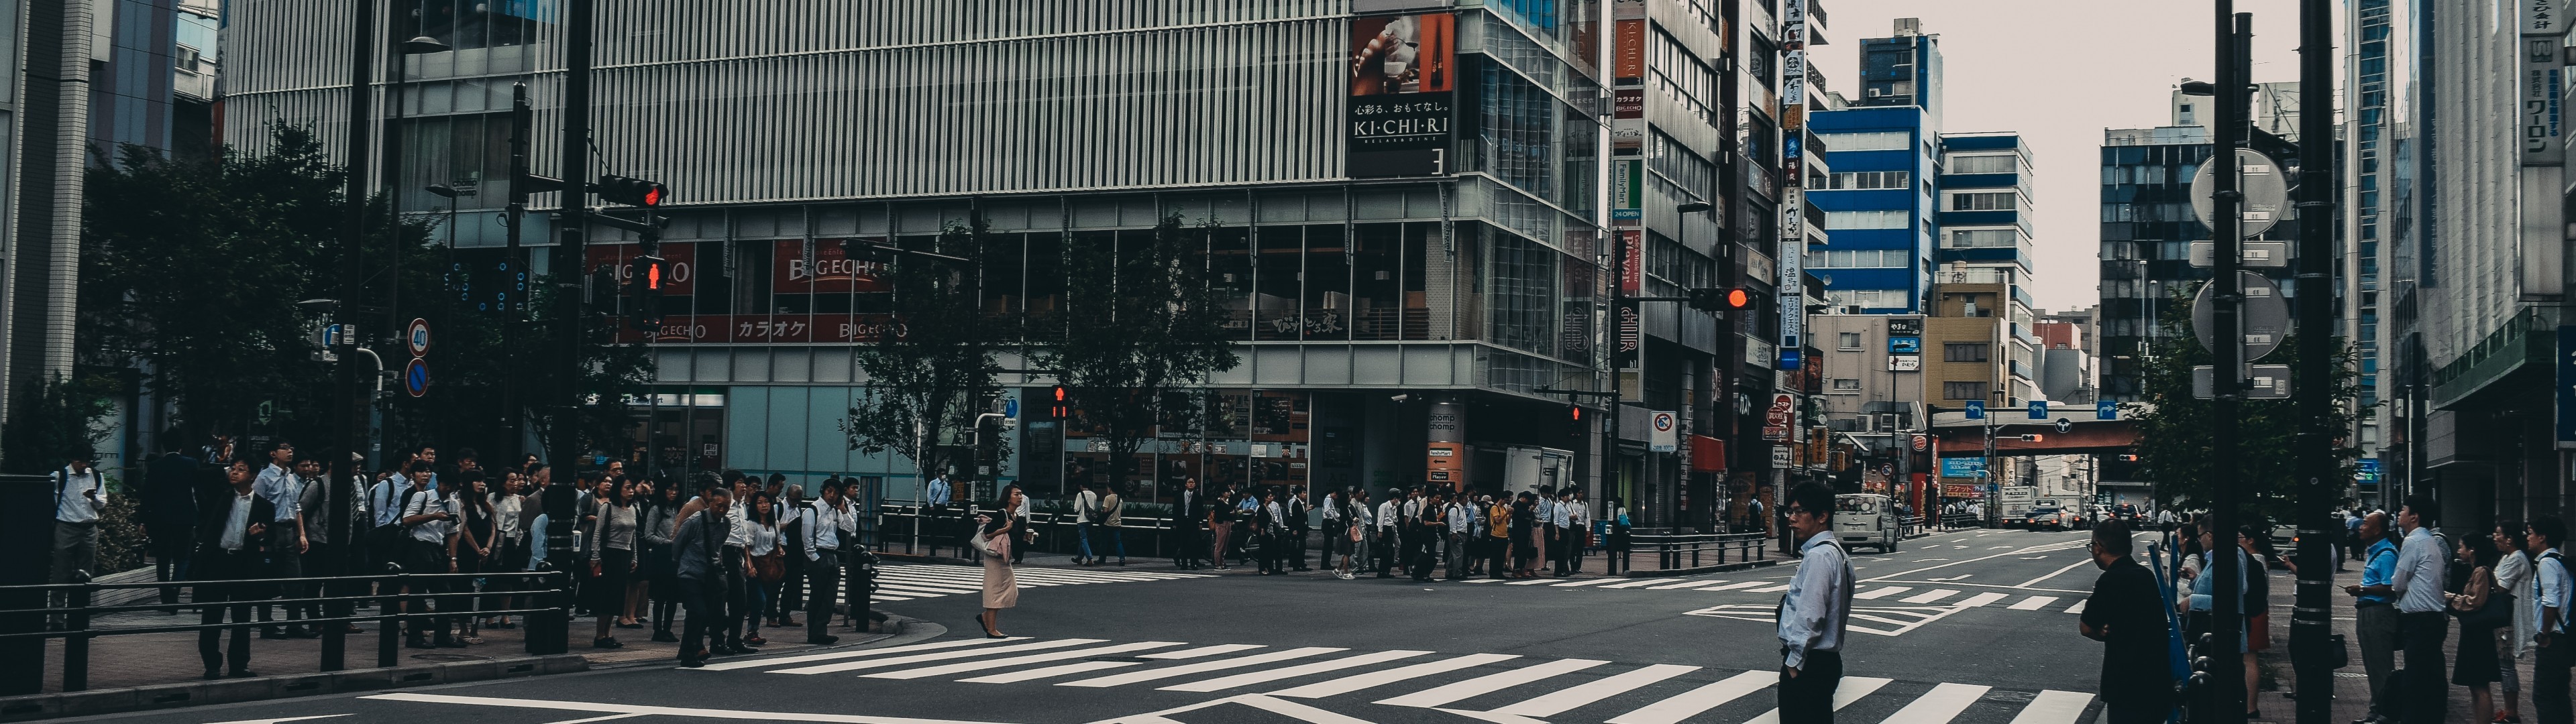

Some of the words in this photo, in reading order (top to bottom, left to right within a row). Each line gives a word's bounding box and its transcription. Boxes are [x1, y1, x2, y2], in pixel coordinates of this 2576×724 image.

[2527, 101, 2546, 153] ワーロン
[1618, 164, 1626, 204] FamilyMart
[790, 260, 826, 281] BG
[670, 324, 706, 339] ECHO
[739, 320, 805, 337] カラオケ
[839, 323, 866, 338] BIG
[413, 329, 426, 347] 40
[1430, 413, 1455, 424] chomp
[1430, 422, 1455, 432] chomp
